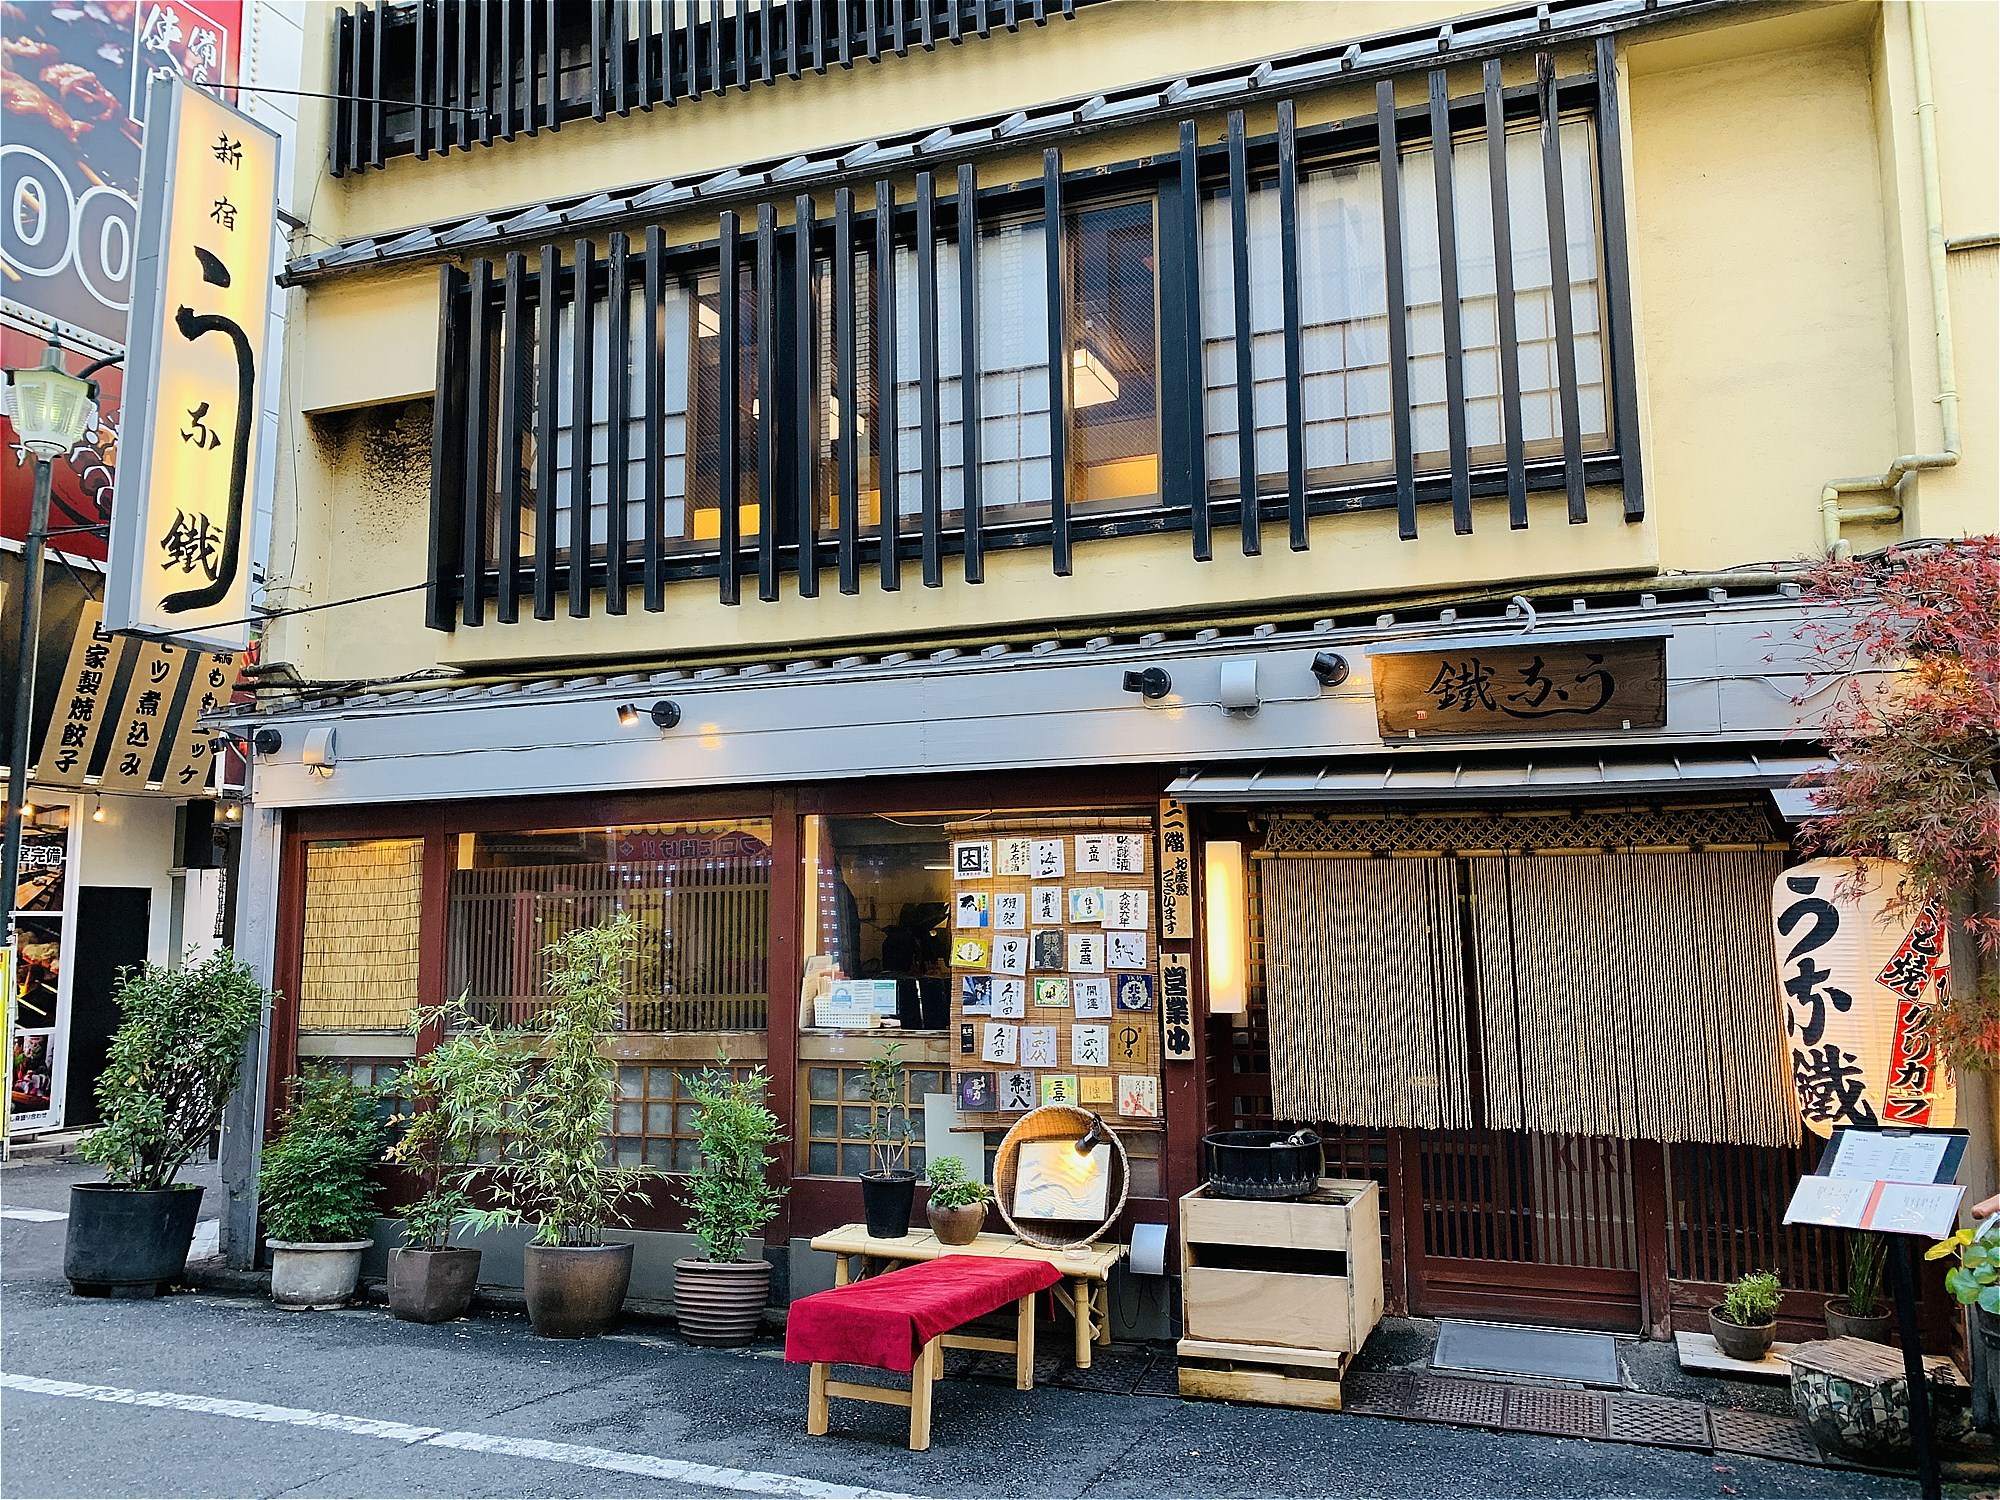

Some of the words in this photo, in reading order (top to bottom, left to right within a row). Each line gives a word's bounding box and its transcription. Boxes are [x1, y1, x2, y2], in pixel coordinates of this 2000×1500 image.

[210, 130, 243, 232] 新宿
[55, 620, 114, 773] 自家製焼餃子
[1163, 807, 1185, 853] 二階
[1039, 842, 1059, 876] 八海山
[1174, 856, 1189, 897] お座敷
[1118, 891, 1132, 928] 文政六年
[1162, 867, 1177, 935] ございます
[1002, 940, 1018, 969] 田酒
[1079, 938, 1093, 966] 三千盛
[999, 982, 1014, 1016] 久保田
[1086, 985, 1099, 1011] 開運
[1164, 966, 1191, 1056] 営業中
[991, 1027, 1006, 1057] 久保田
[1030, 1030, 1048, 1064] 十四代
[1081, 1028, 1099, 1064] 十四代
[1052, 1080, 1066, 1102] 三岳
